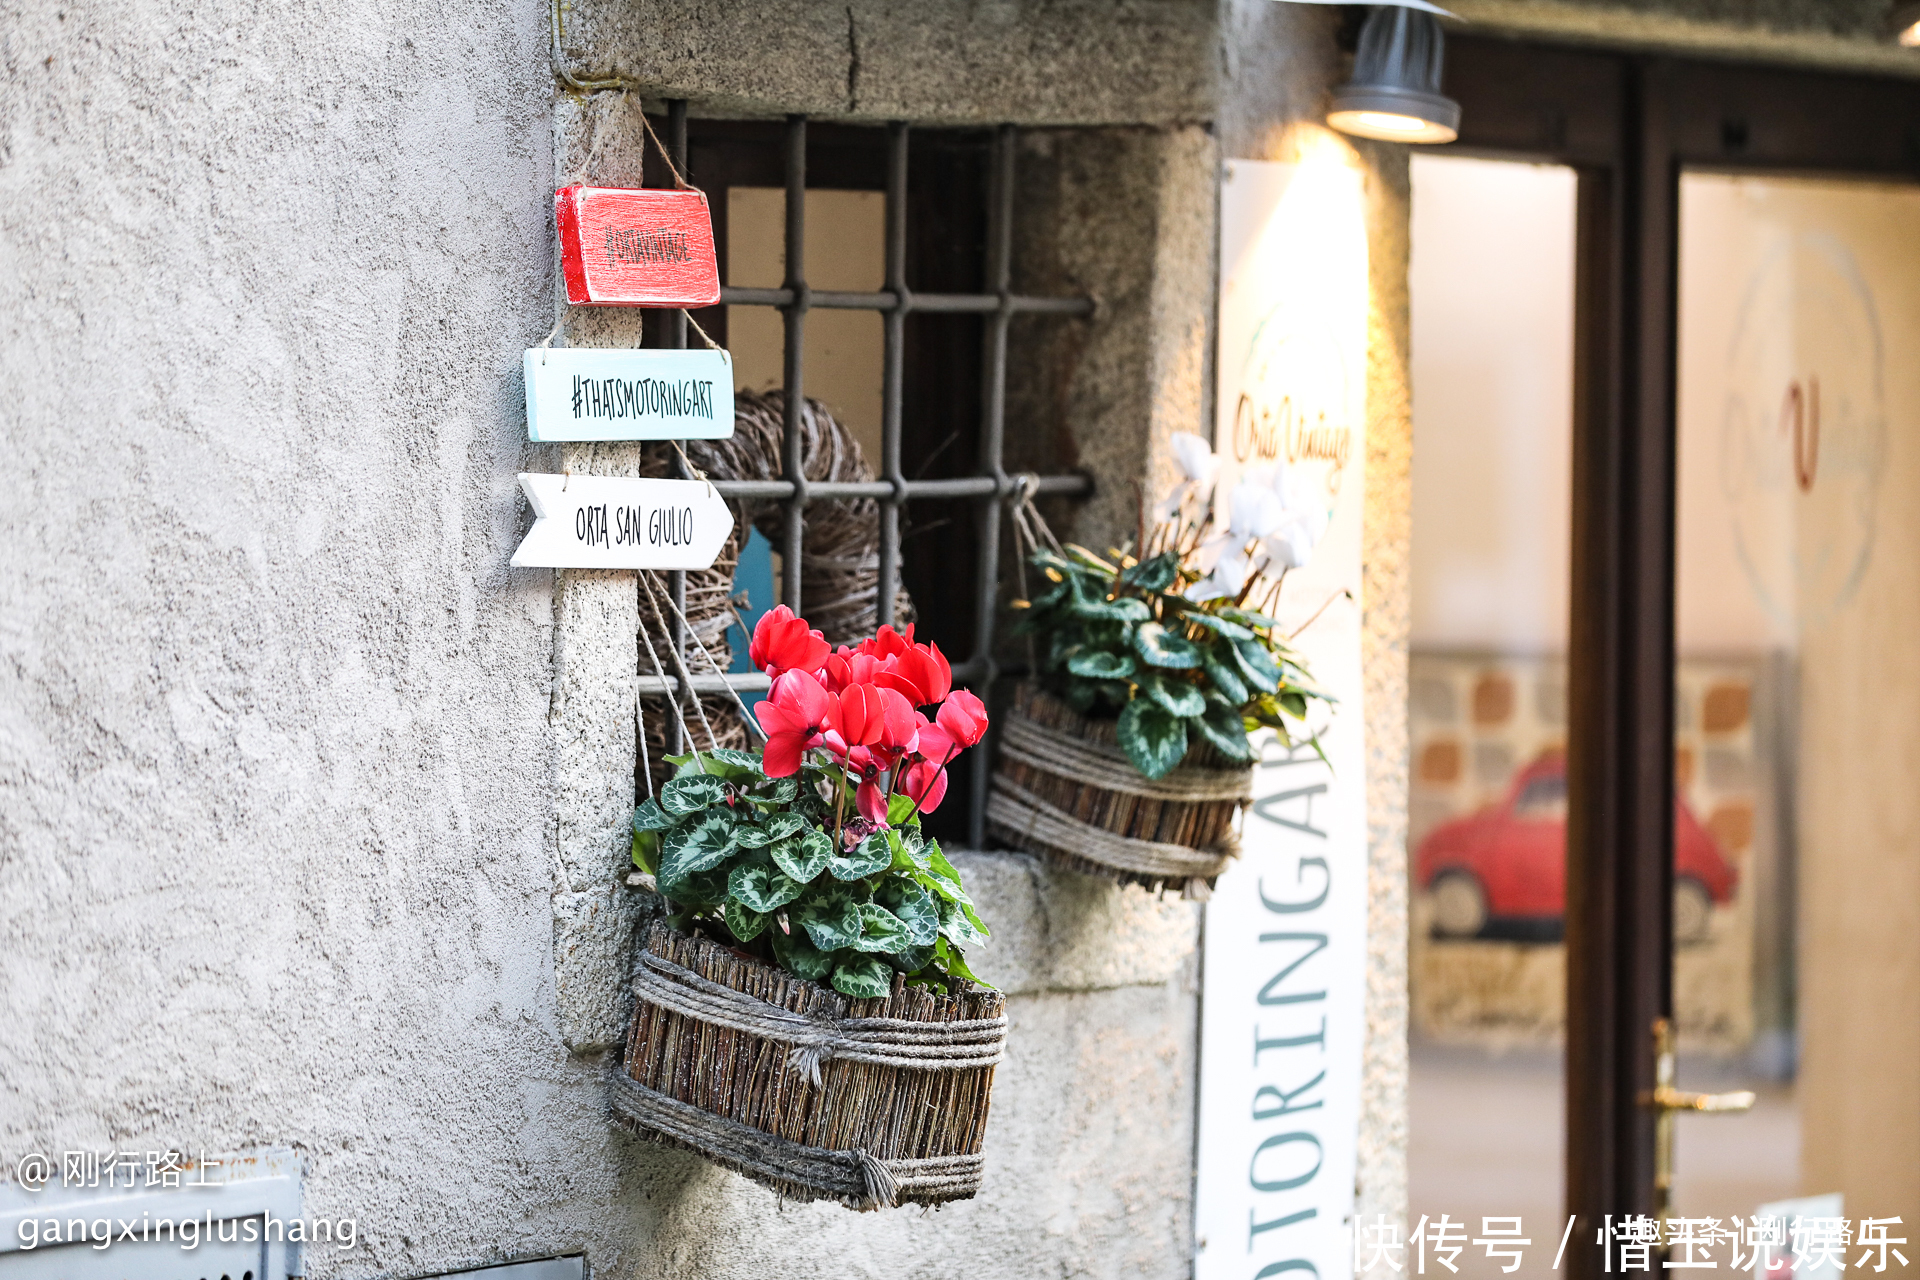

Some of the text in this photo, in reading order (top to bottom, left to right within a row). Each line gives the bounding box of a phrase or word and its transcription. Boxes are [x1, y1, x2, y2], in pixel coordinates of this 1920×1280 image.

[604, 225, 693, 270] #ORTAVINTAGE
[571, 374, 714, 421] #THATSMOTORINGART
[576, 503, 693, 550] ORTA SAN GIULIO
